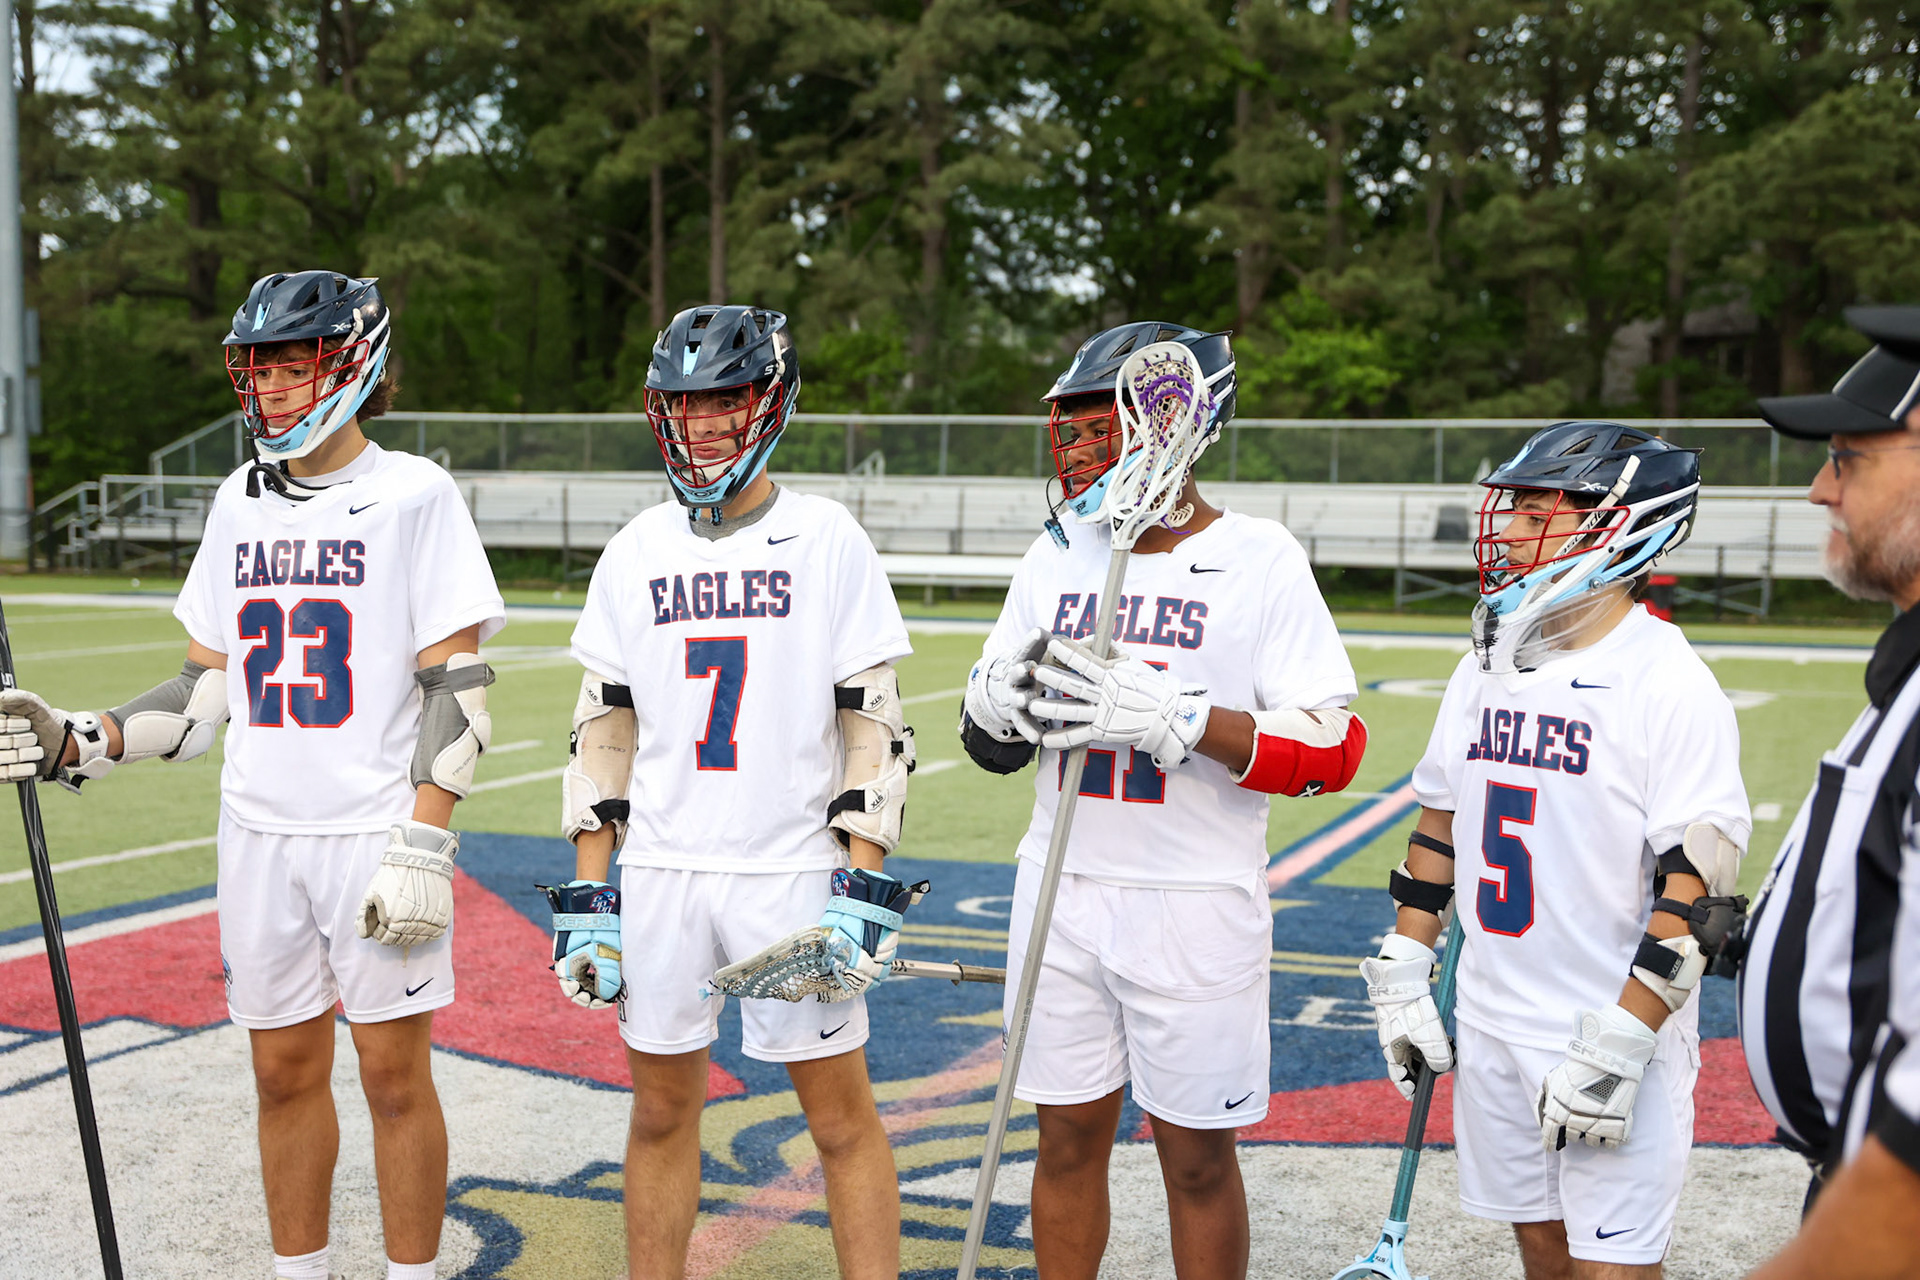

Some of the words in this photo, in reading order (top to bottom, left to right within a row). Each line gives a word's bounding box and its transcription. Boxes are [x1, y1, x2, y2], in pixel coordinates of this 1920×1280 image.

[235, 539, 366, 588] EAGLES
[649, 570, 792, 626] EAGLES
[237, 598, 354, 729] 23
[685, 636, 748, 771] 7
[869, 694, 883, 708] STX
[1466, 707, 1593, 776] AGLES
[580, 818, 595, 827] STX
[382, 851, 455, 874] TEMPE
[1476, 779, 1538, 938] 5
[1670, 958, 1683, 976] STX
